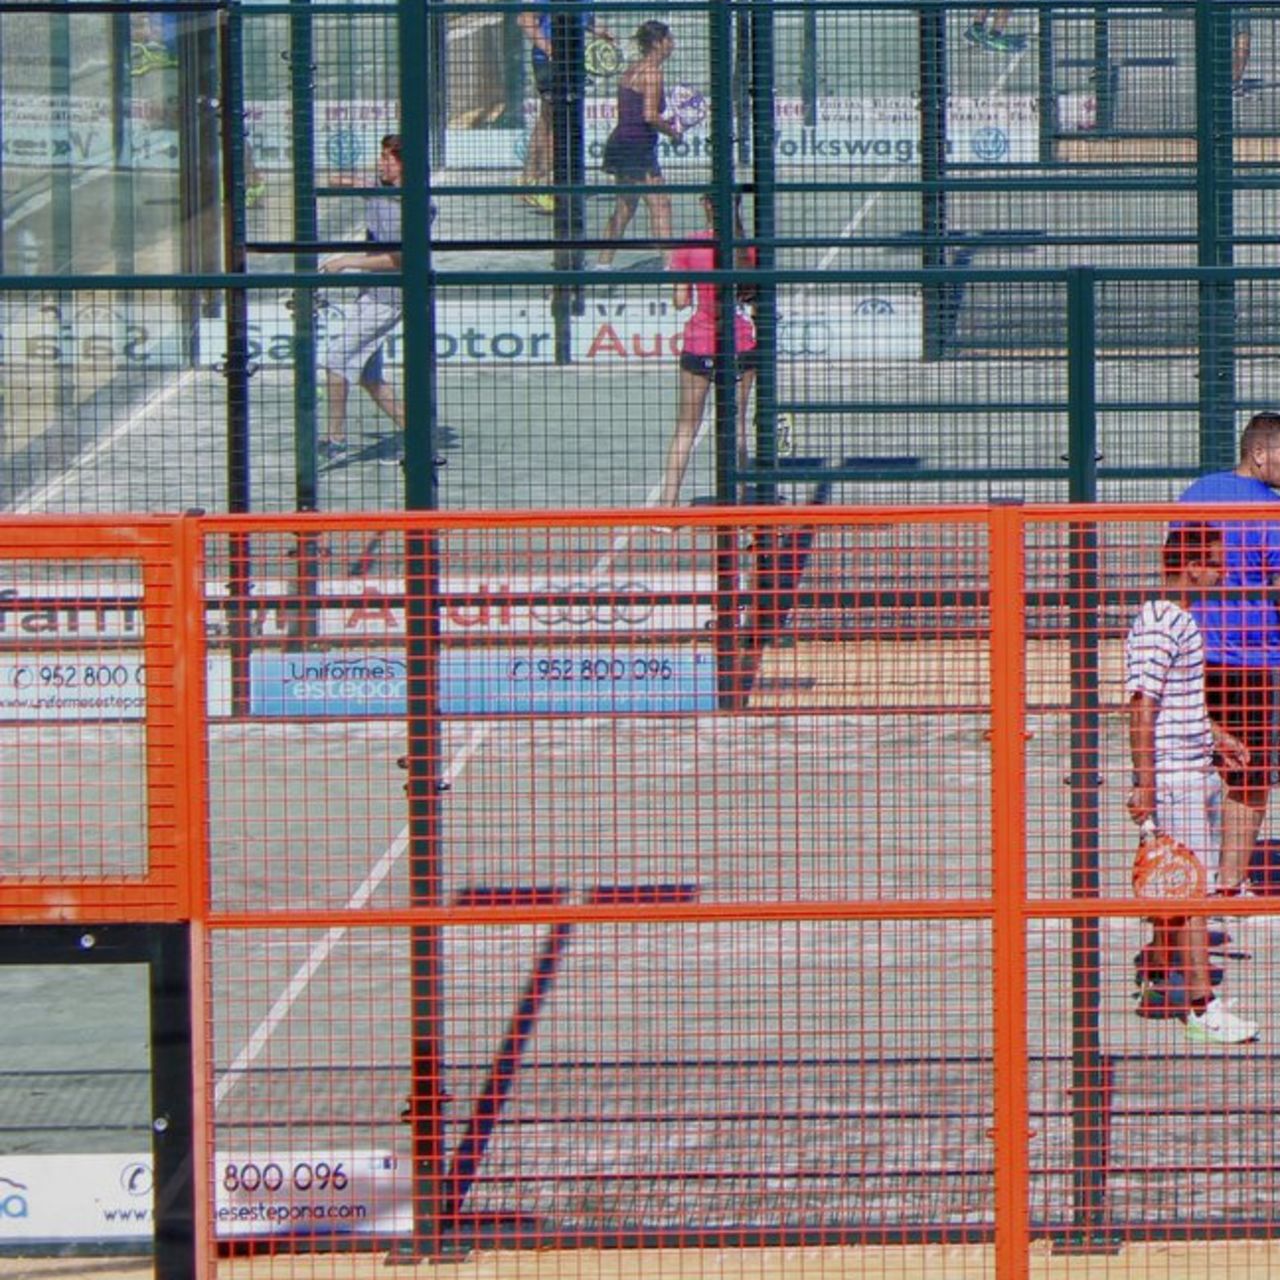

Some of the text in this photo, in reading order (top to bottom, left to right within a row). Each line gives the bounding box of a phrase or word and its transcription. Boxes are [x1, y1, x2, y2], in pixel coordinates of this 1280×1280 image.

[344, 584, 511, 628] Adi
[40, 665, 77, 688] 952
[83, 665, 129, 687] 800
[291, 663, 396, 681] Uniformes
[537, 658, 672, 680] 952 800 096
[223, 1163, 349, 1193] 800 096
